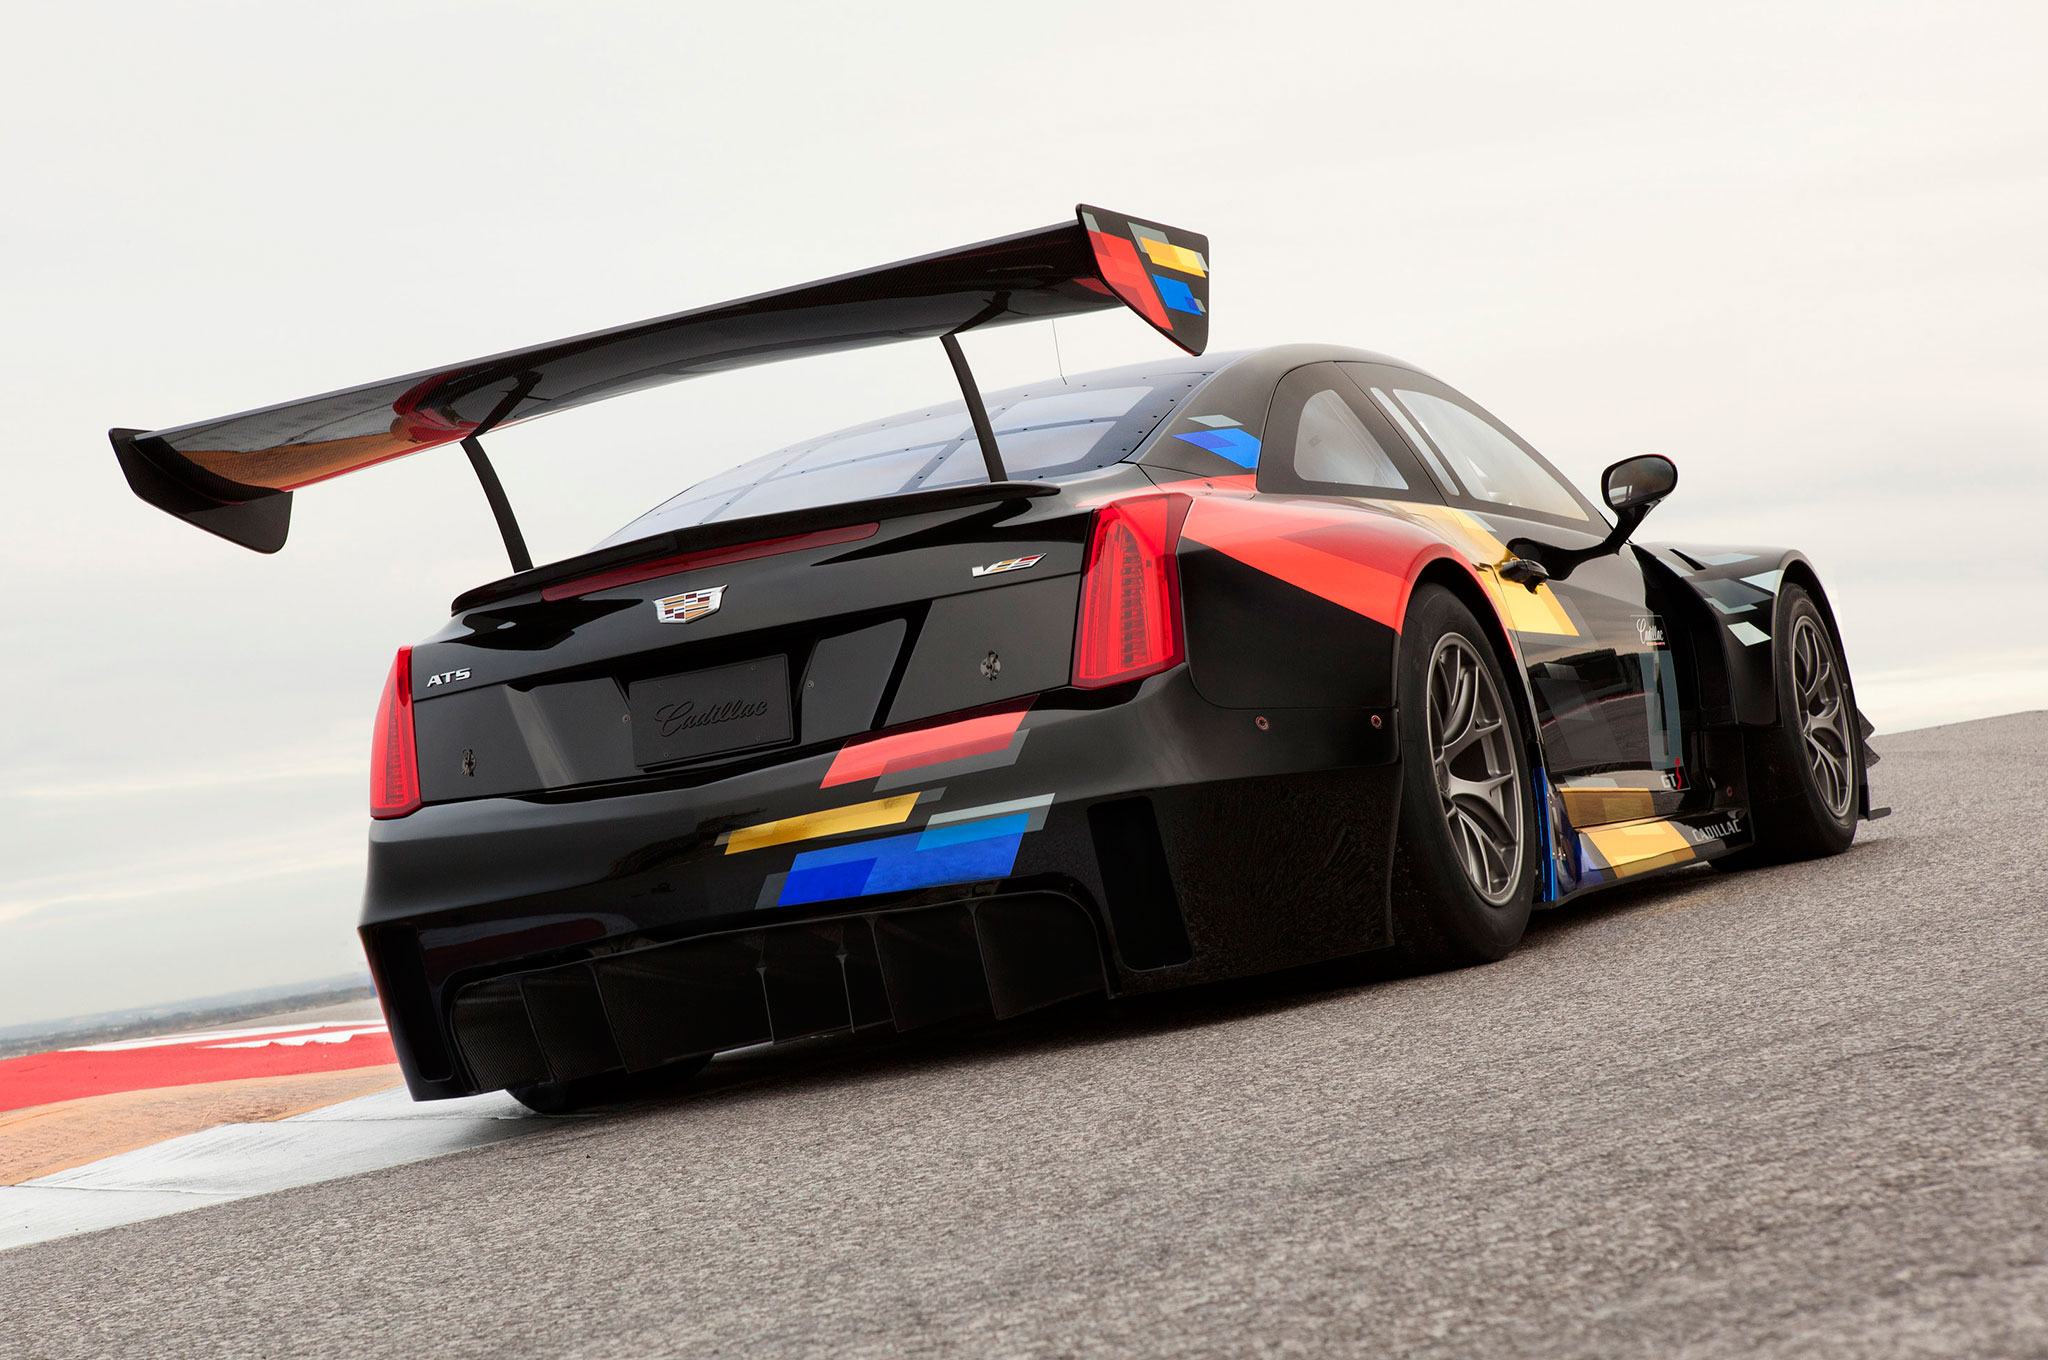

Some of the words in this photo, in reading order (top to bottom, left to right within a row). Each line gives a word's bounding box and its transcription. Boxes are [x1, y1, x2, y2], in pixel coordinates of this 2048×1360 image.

[1636, 617, 1665, 645] Cadillac
[426, 667, 472, 688] ATS
[654, 699, 768, 738] Cadillac
[1691, 819, 1742, 842] CADILLAC
